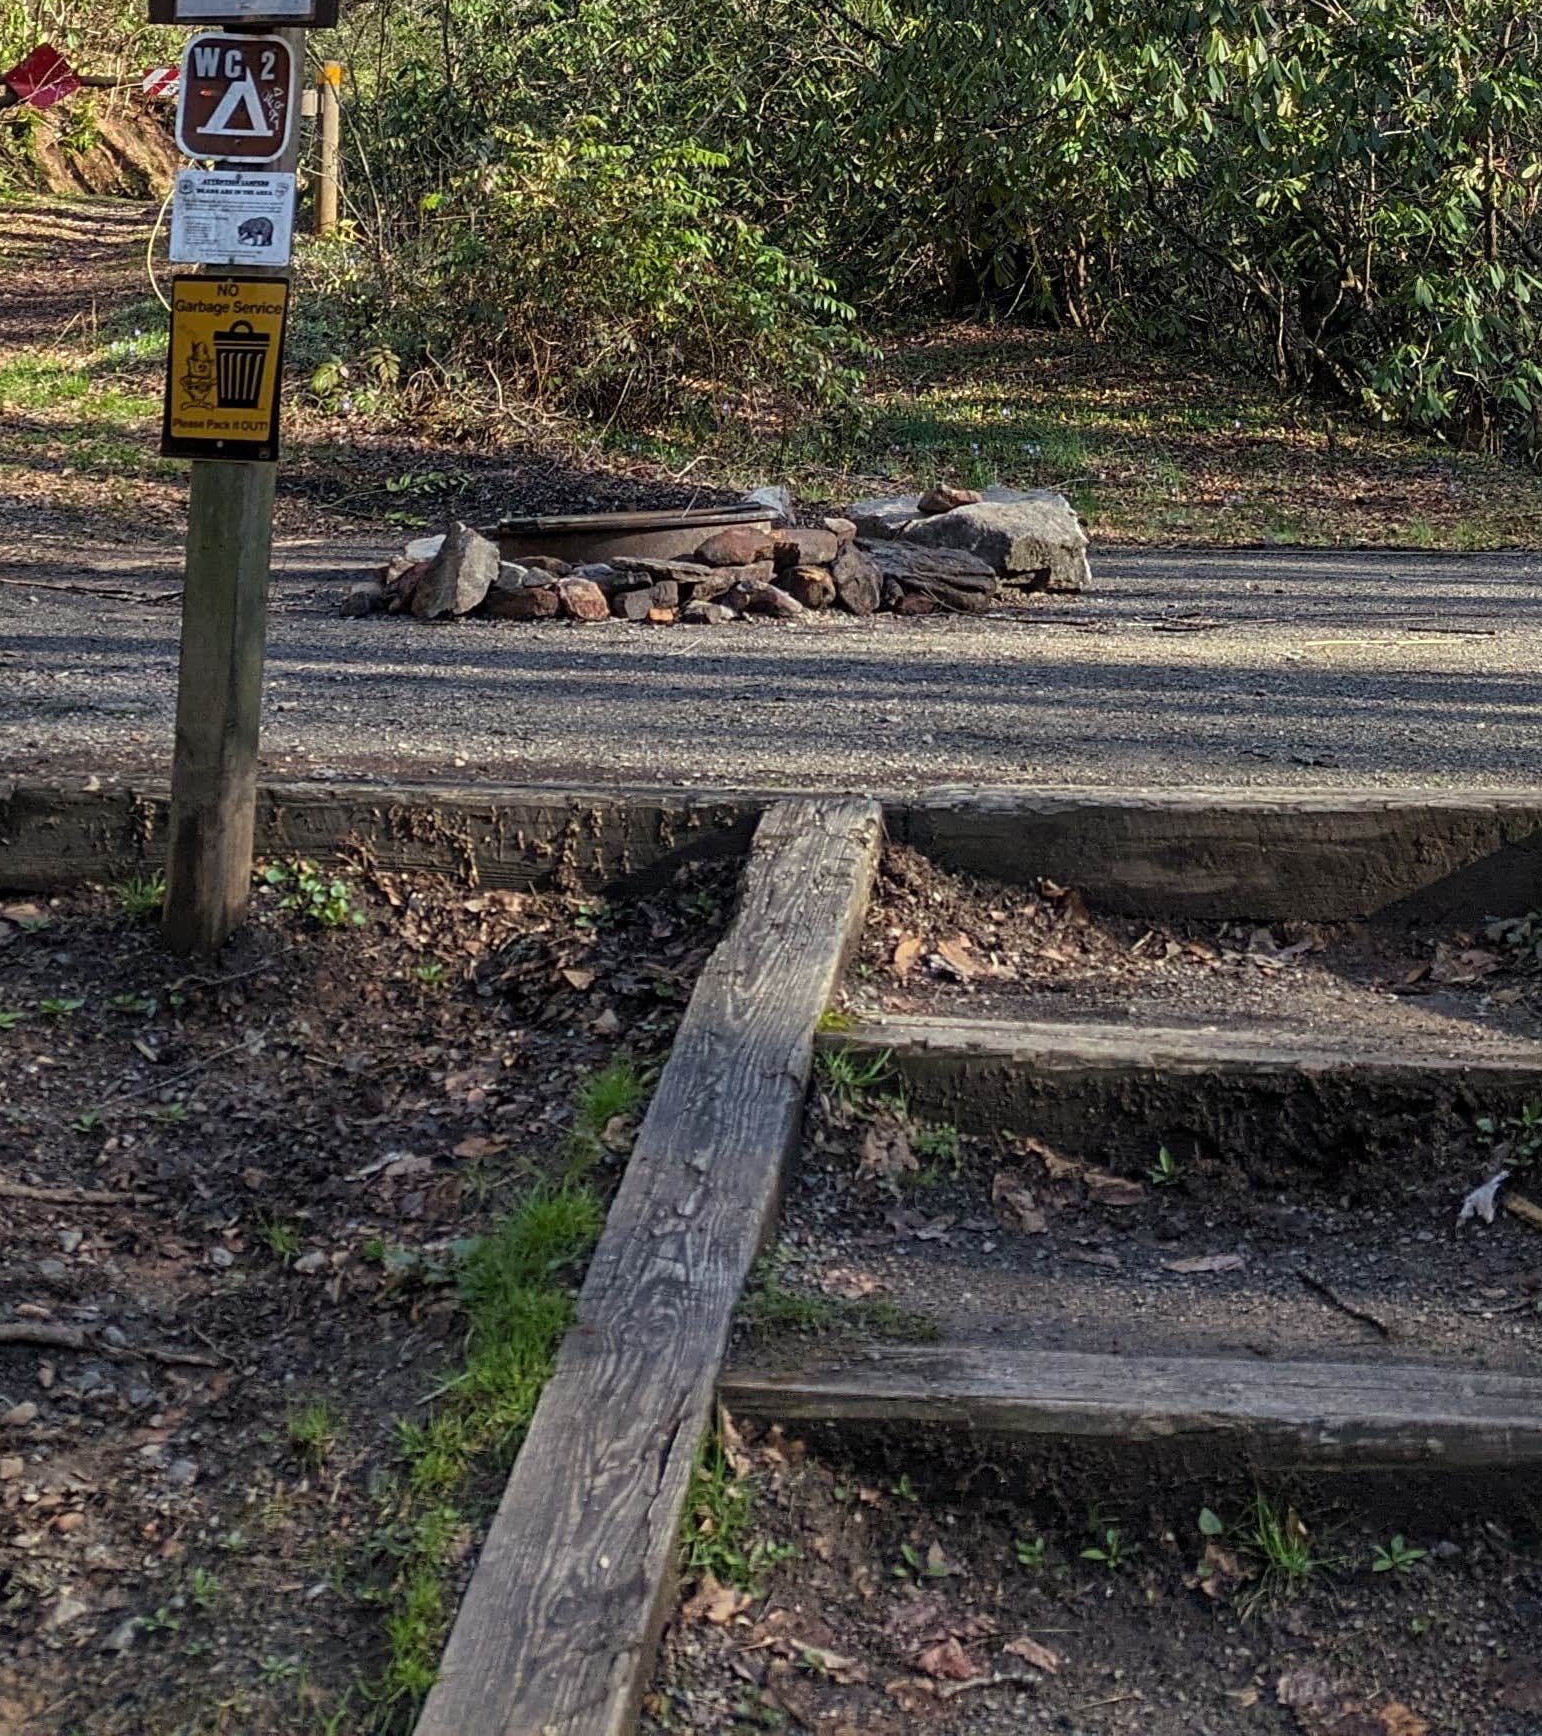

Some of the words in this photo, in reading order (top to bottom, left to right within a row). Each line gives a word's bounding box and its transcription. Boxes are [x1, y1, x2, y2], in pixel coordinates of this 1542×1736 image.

[194, 47, 242, 79] WC
[260, 50, 276, 81] 2
[217, 284, 239, 297] NO
[175, 299, 230, 316] Garbage
[233, 300, 283, 315] Service
[172, 417, 205, 429] Please
[206, 418, 230, 430] Pack
